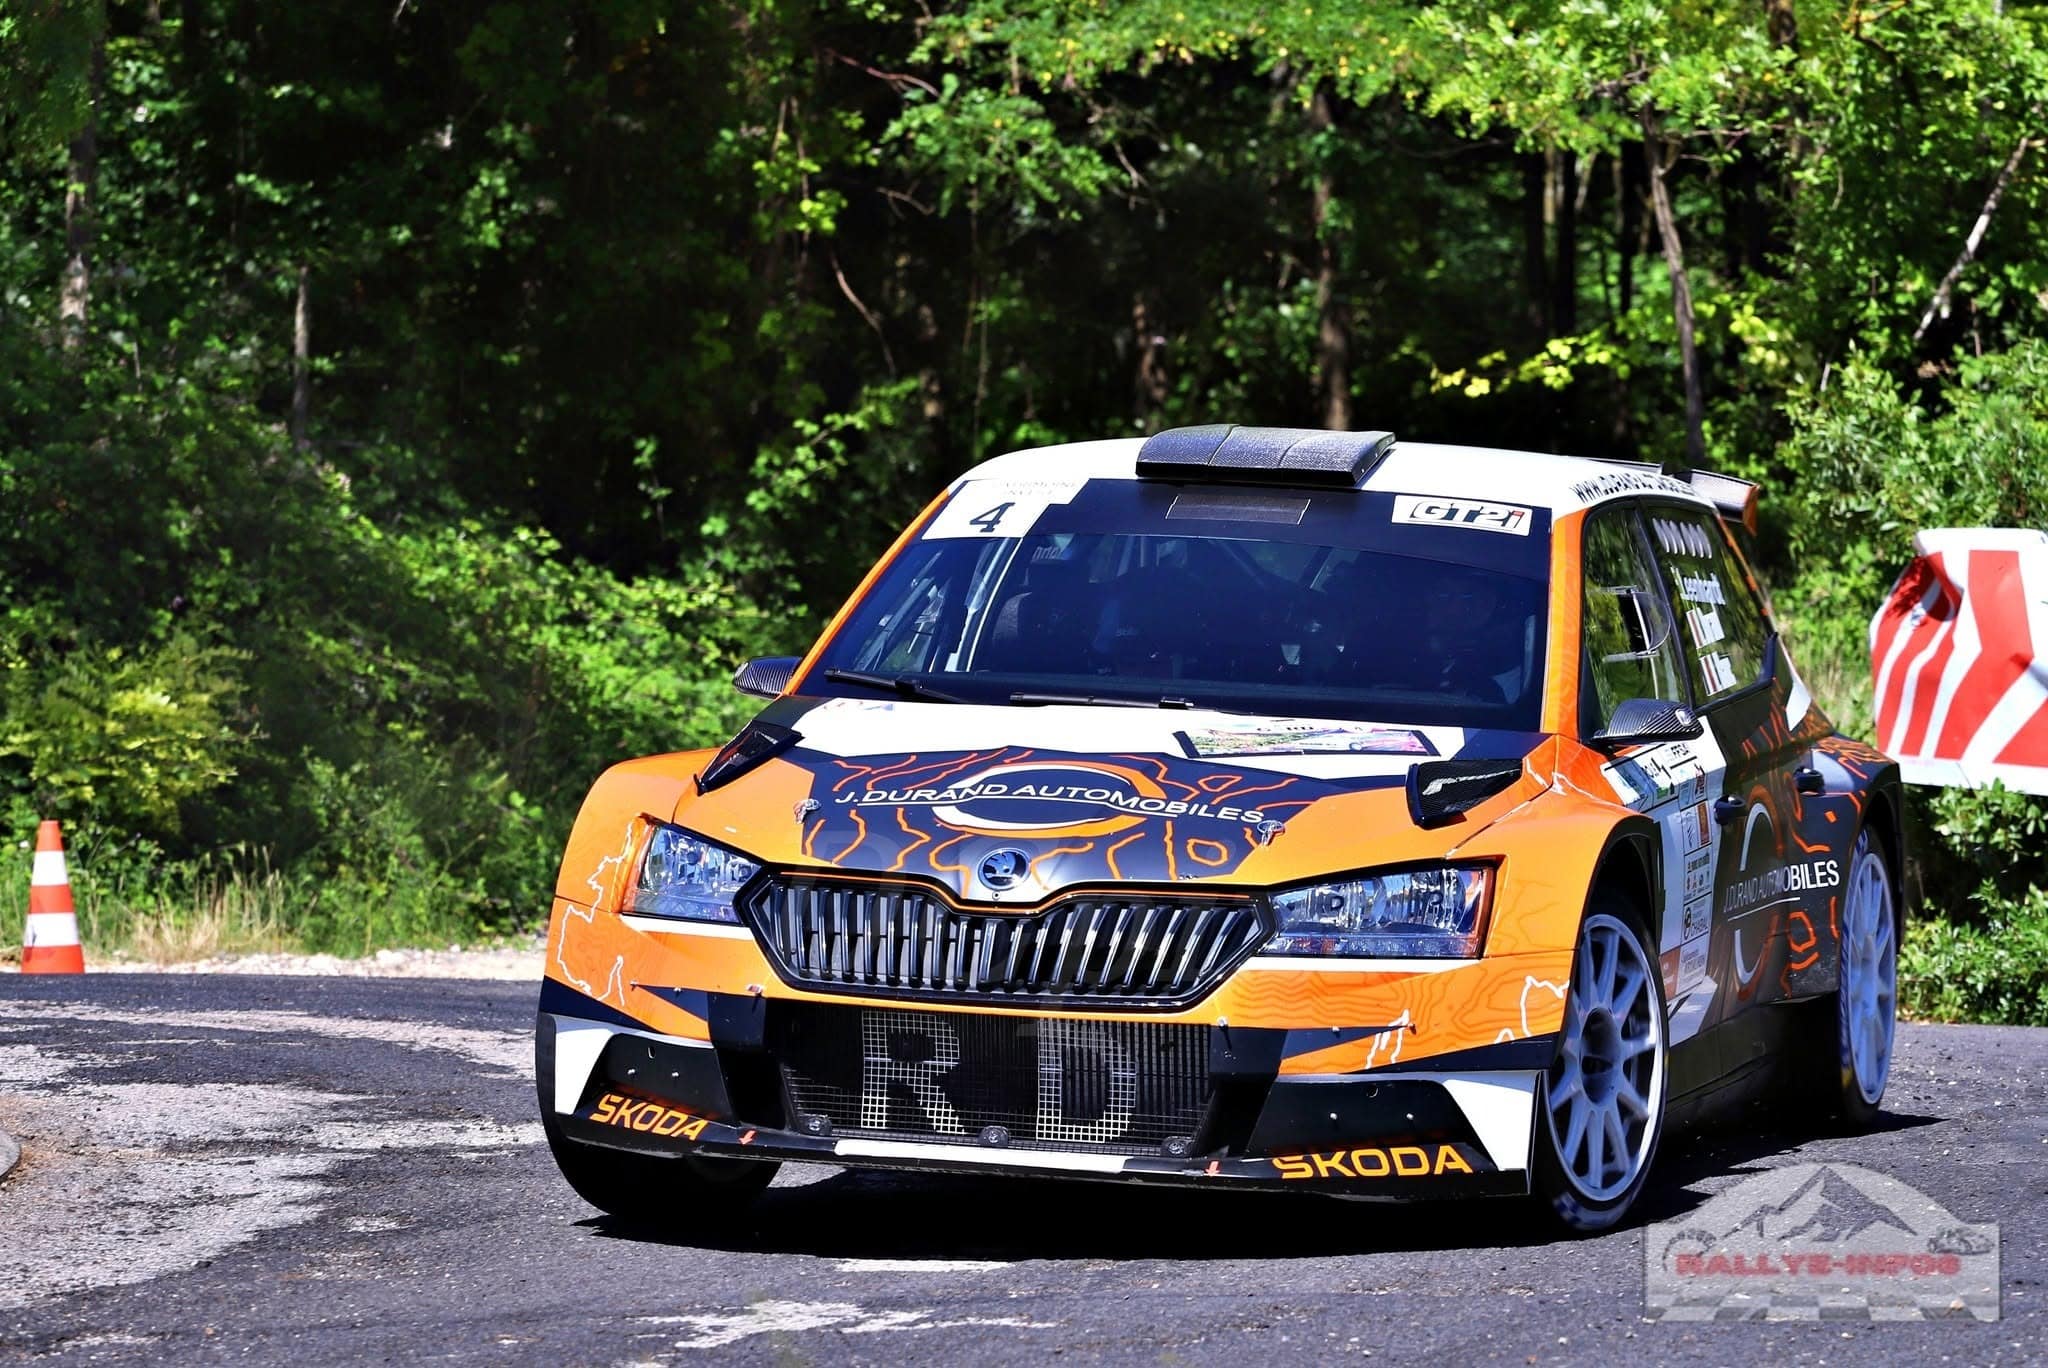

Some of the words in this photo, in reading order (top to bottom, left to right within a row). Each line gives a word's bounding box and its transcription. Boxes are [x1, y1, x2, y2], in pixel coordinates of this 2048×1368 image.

[968, 501, 1016, 533] 4
[834, 784, 1008, 804] J.DURAND
[1012, 784, 1265, 824] AUTOMOBILES
[1757, 859, 1841, 902] AUTOMOBILES
